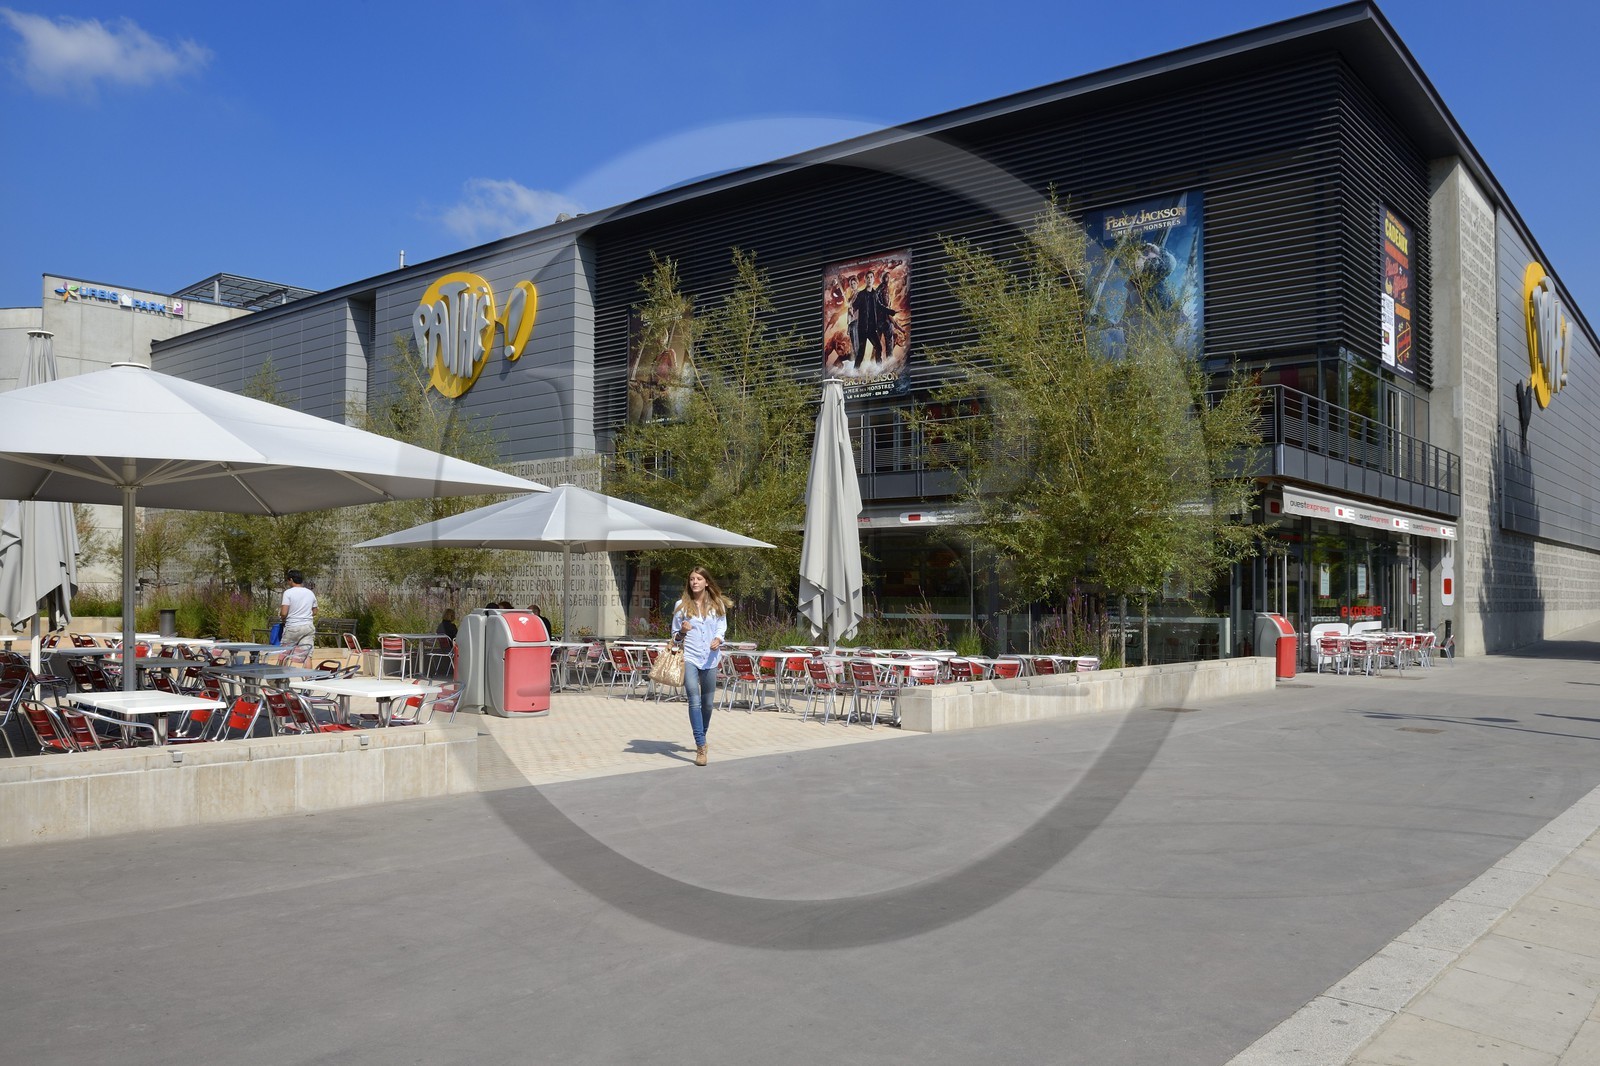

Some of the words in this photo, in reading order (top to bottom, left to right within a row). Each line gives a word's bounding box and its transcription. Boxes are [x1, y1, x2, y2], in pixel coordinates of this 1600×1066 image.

[1136, 207, 1186, 225] JACKSON
[1143, 219, 1181, 231] MONSTRES
[79, 286, 119, 302] URBIS
[132, 298, 166, 313] PARK
[862, 370, 899, 385] JACKSON
[866, 383, 895, 391] MONSTRES
[555, 564, 586, 577] CAERA
[536, 579, 586, 591] PRODUCEUR
[568, 594, 608, 607] SCENARIO
